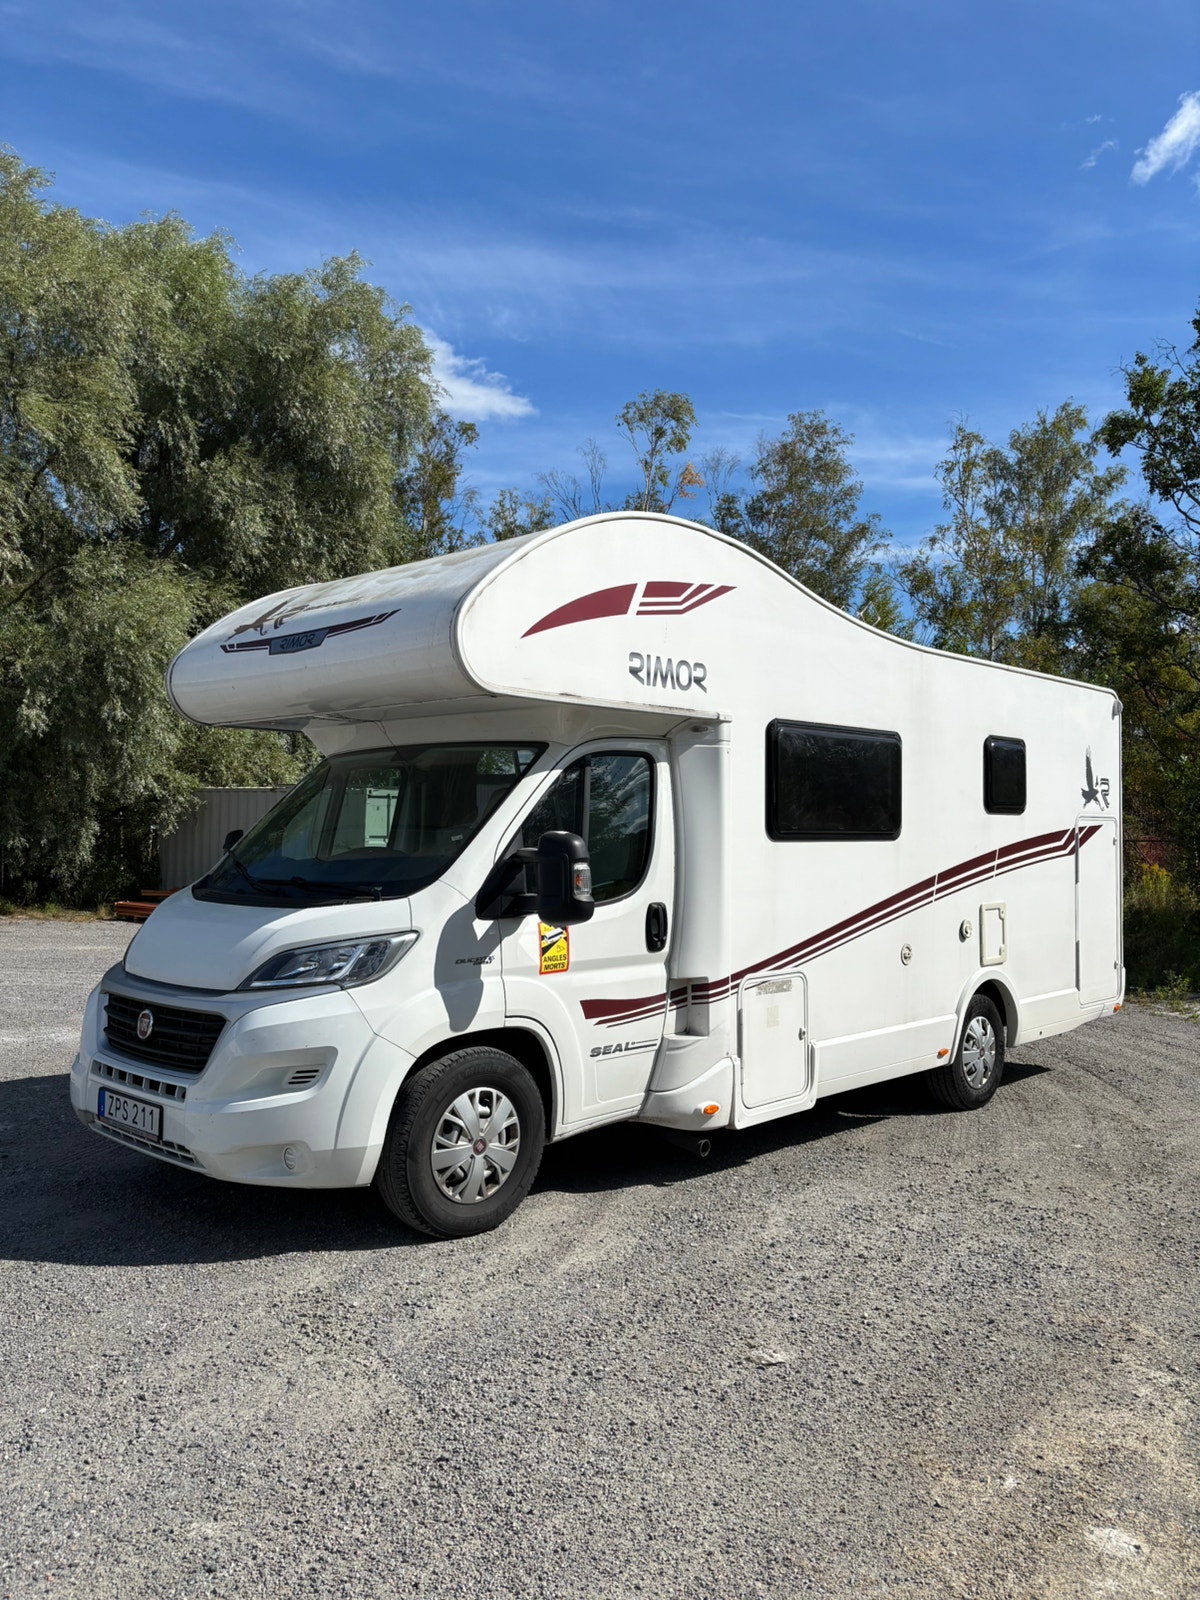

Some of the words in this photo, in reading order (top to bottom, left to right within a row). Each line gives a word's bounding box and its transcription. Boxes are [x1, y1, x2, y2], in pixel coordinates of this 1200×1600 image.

[279, 633, 316, 649] RIMOR
[628, 651, 708, 694] RIMOR
[543, 953, 567, 963] ANGLES
[543, 962, 566, 971] MORTS
[589, 1041, 633, 1058] SEAL
[108, 1095, 129, 1121] ZPS
[132, 1103, 154, 1131] 211
